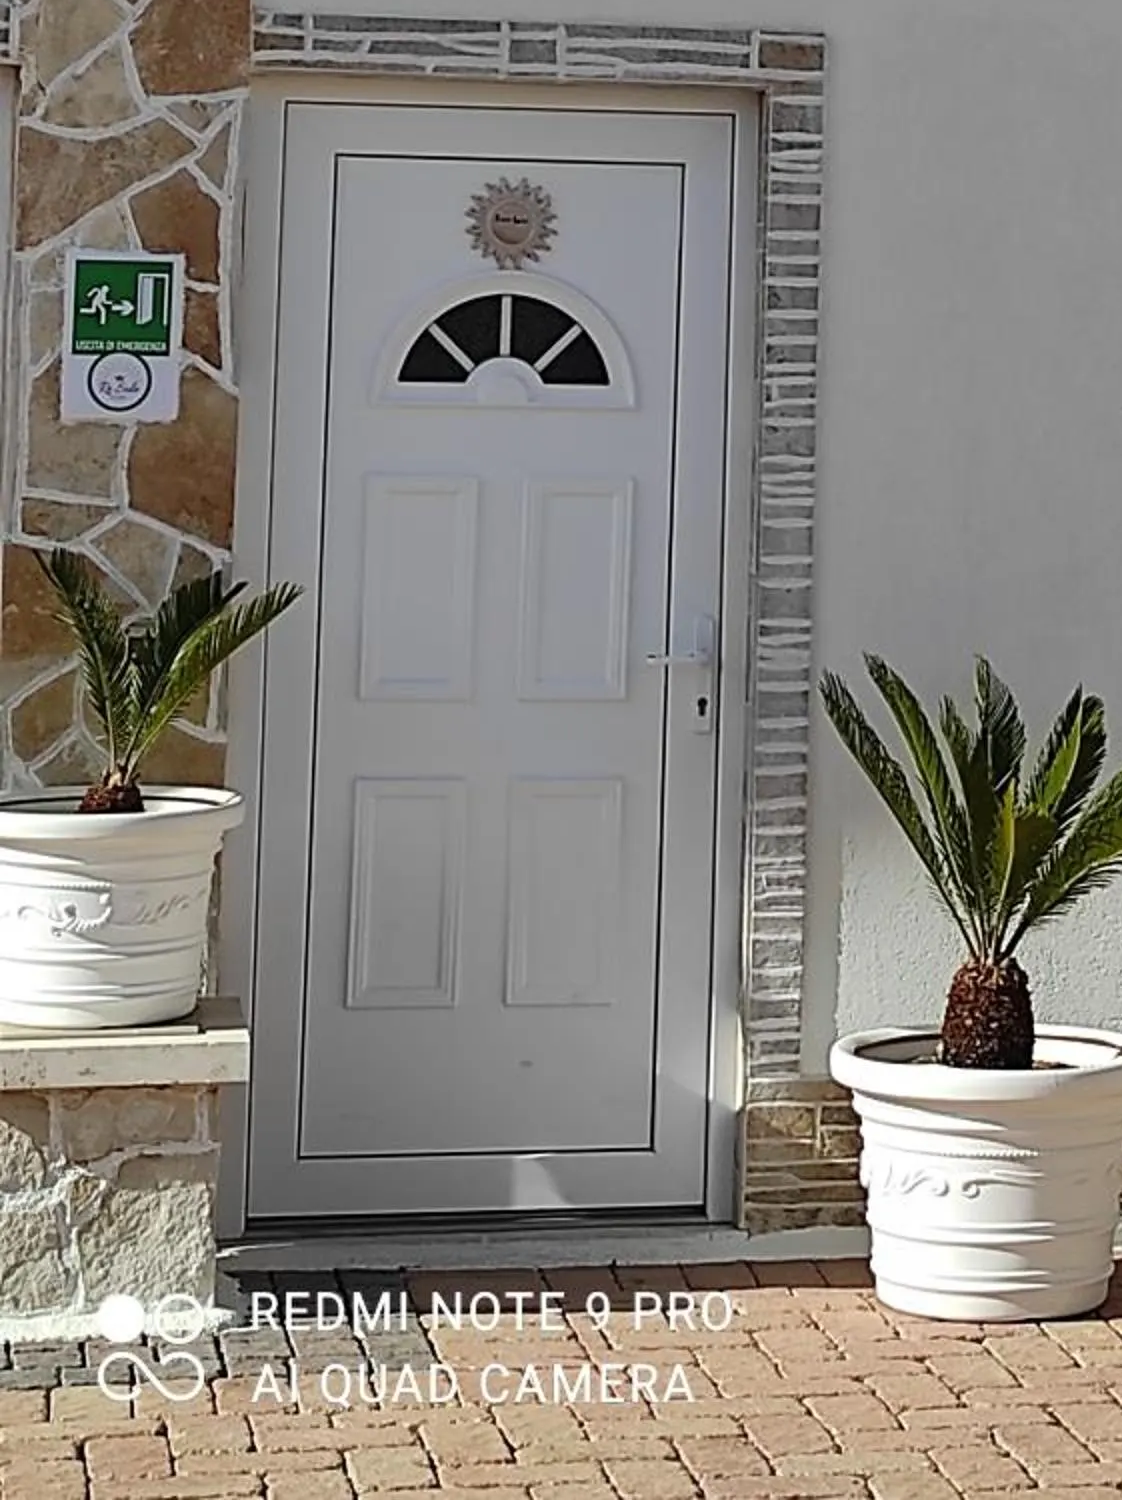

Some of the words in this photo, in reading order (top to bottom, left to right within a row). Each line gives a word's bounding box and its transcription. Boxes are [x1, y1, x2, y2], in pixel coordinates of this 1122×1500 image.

[76, 340, 104, 350] USCITA
[106, 340, 115, 350] DI
[116, 341, 166, 351] EMERGENZA
